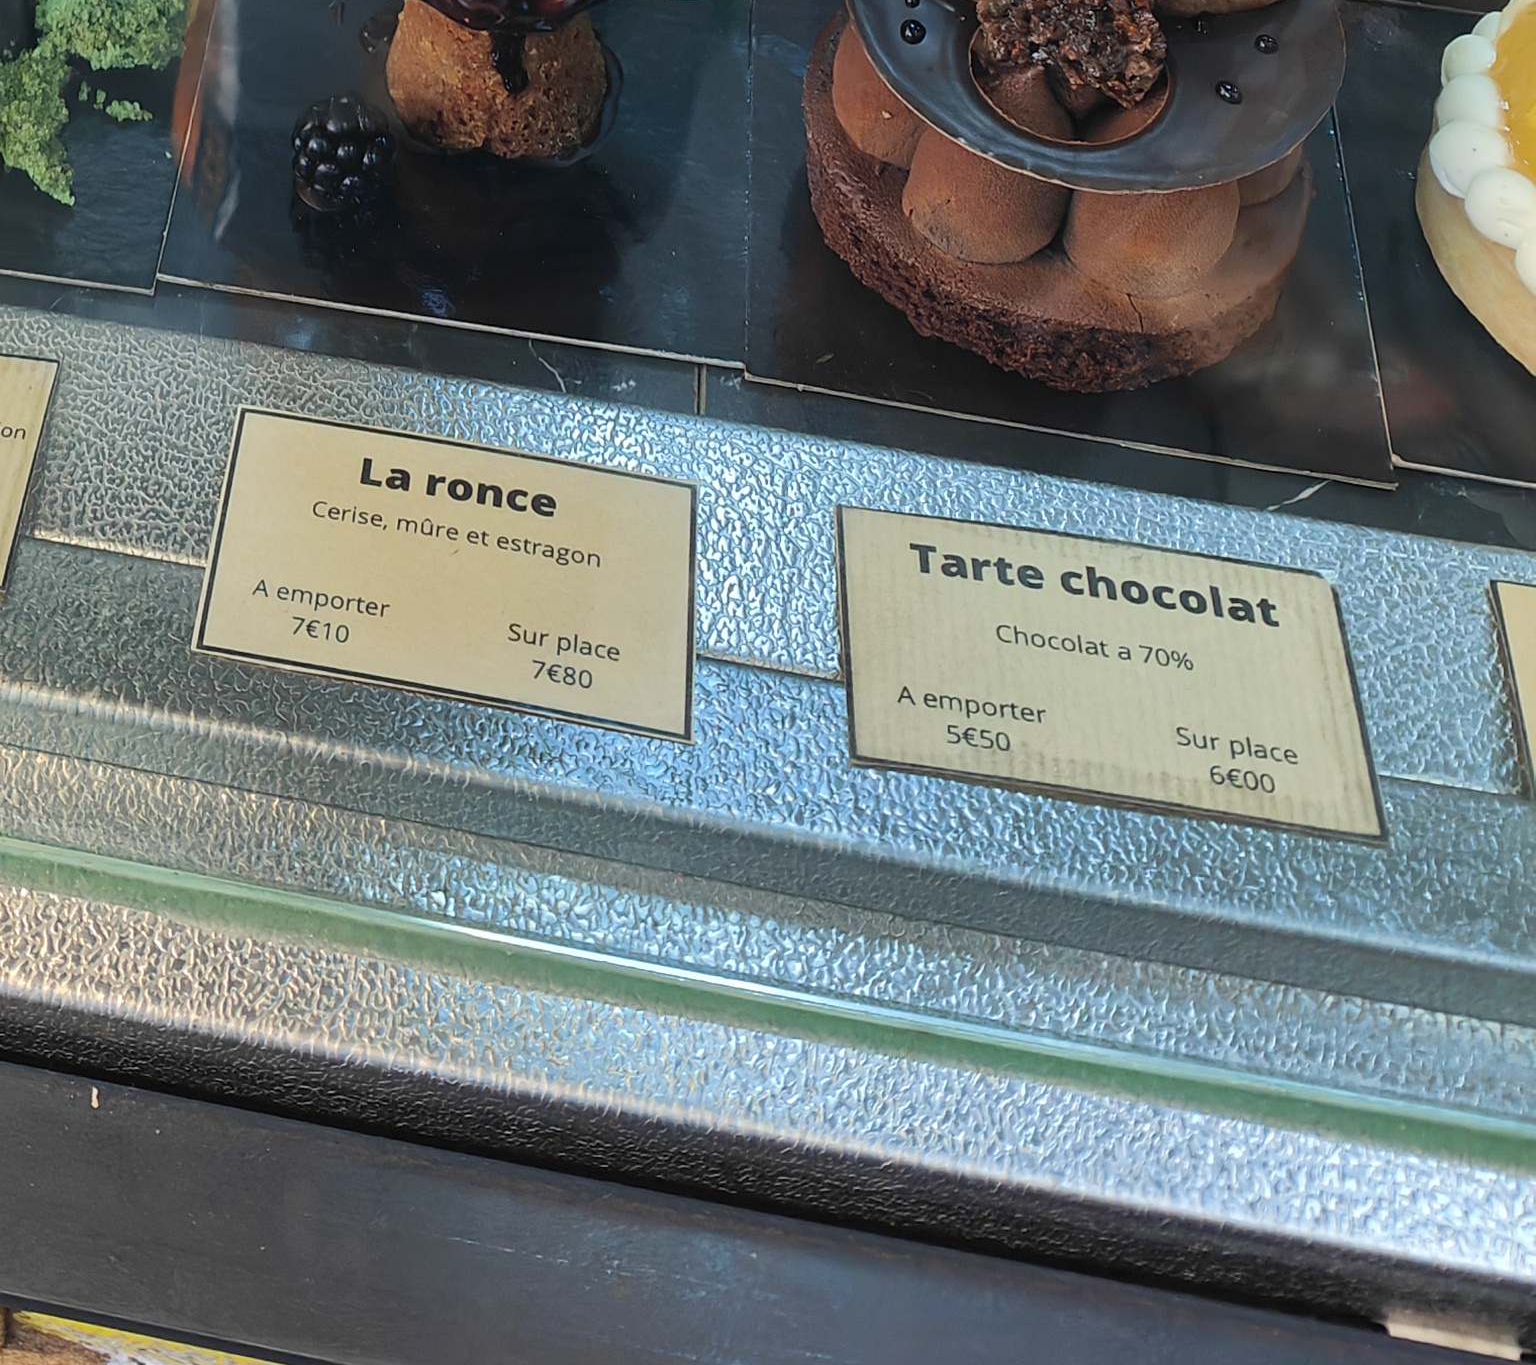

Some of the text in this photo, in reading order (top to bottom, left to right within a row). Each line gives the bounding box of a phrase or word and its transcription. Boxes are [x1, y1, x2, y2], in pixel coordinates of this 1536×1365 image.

[359, 457, 557, 518] La ronce
[312, 500, 601, 568] Cerise, mûre et estragon
[251, 578, 391, 618] A emporter
[908, 542, 1281, 628] Tarte chocolat
[291, 615, 350, 644] 7€10
[507, 622, 621, 662] Sur place
[995, 624, 1195, 671] Chocolat a 70%
[531, 659, 593, 690] 7€80
[896, 685, 1047, 724] A emporter
[946, 724, 1011, 752] 5€50
[1175, 726, 1299, 766] Sur place
[1209, 764, 1276, 794] 6€00
